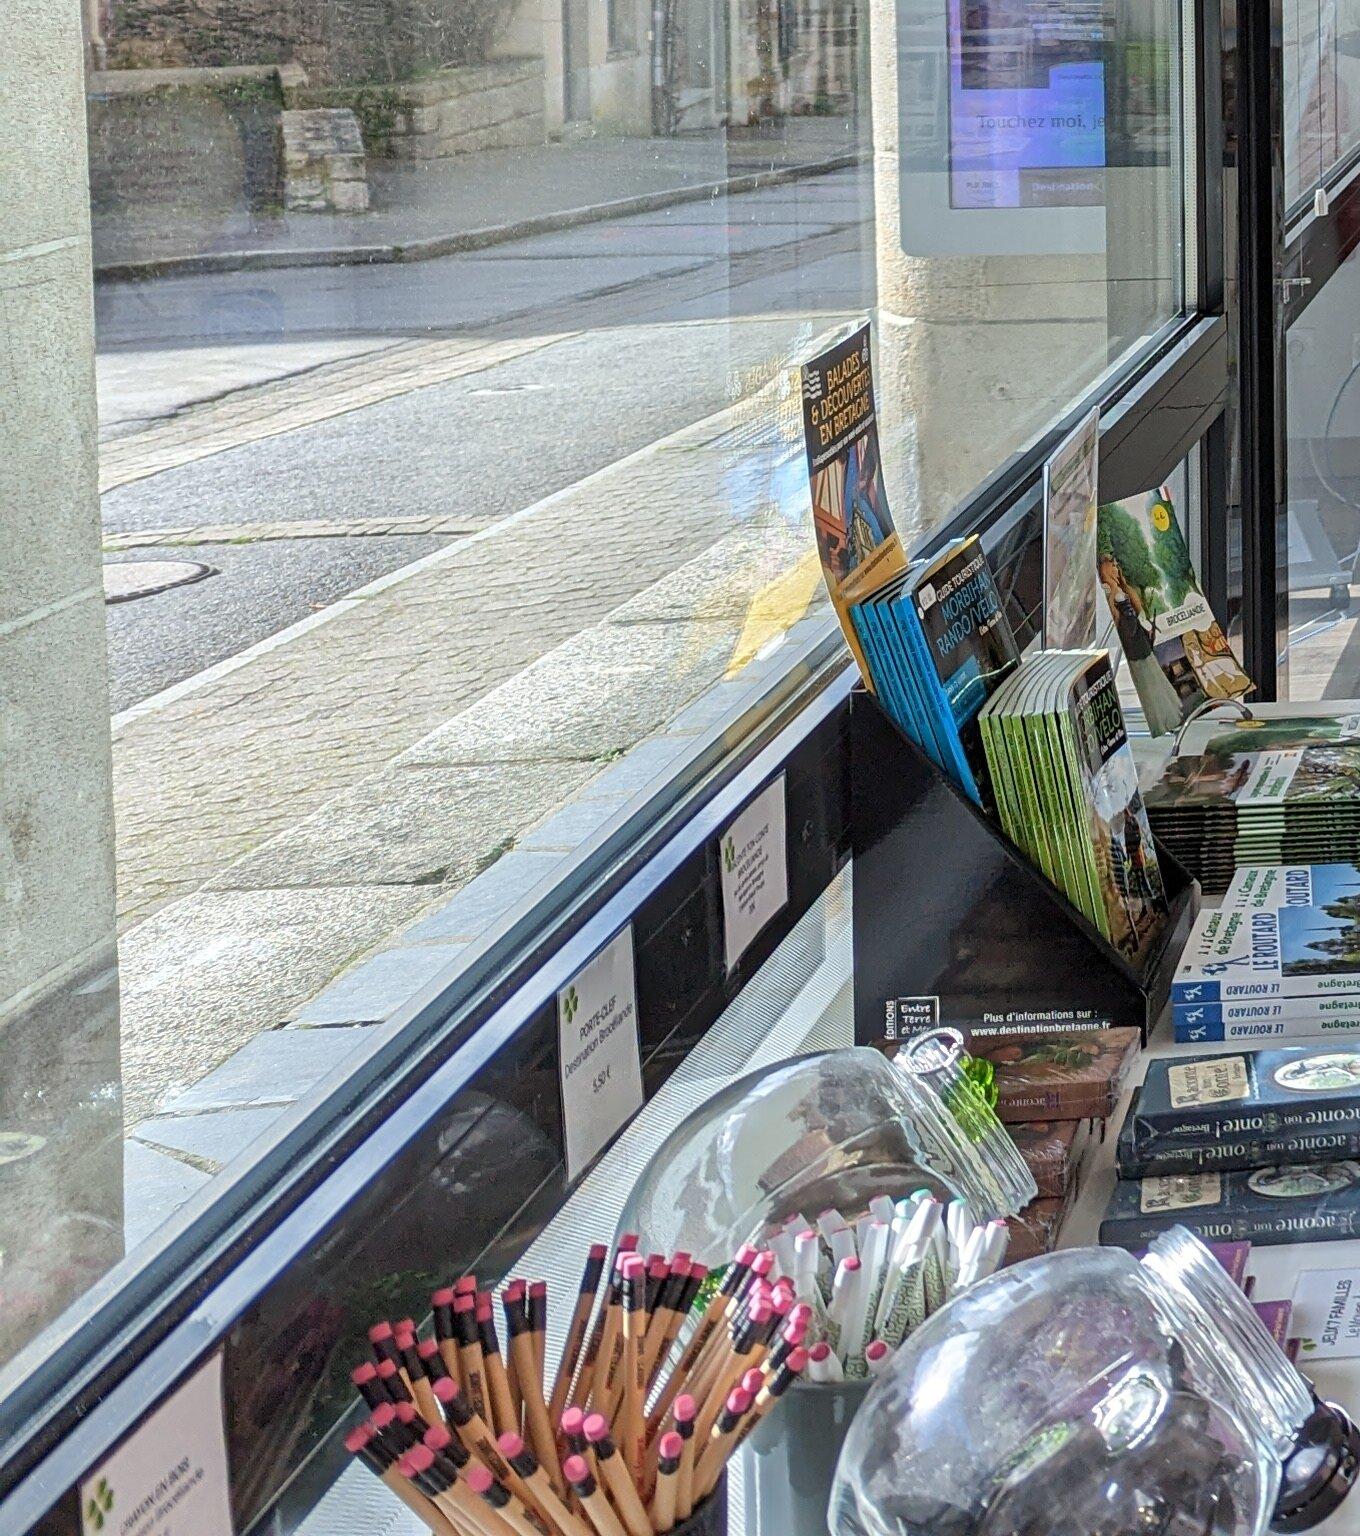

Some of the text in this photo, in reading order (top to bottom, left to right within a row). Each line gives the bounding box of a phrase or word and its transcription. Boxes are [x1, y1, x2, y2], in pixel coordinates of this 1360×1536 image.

[976, 114, 1045, 129] Touchez
[826, 350, 860, 391] BALADES
[811, 405, 819, 426] &
[819, 419, 834, 445] EN
[833, 391, 870, 437] BRETAGNE
[936, 553, 985, 602] GUIDE TOURISTIQUE
[941, 570, 991, 625] MORBIHAN
[1238, 869, 1259, 894] Canaux
[1250, 869, 1278, 908] de Bretagne
[1285, 869, 1310, 906] OUTARD
[1201, 912, 1223, 939] Canaux
[1214, 912, 1243, 956] de Bretagne
[1251, 912, 1279, 971] LE ROUTARD
[1226, 983, 1281, 995] LE ROUTARD
[900, 1004, 931, 1014] Entre
[902, 1014, 931, 1024] Terre
[983, 1013, 1004, 1023] Plus
[1006, 1010, 1074, 1023] d'informations
[1076, 1010, 1092, 1019] sur
[1227, 1005, 1282, 1018] LE ROUTARD
[884, 1000, 895, 1040] ÉDITIONS
[901, 1025, 910, 1035] et
[970, 1021, 1111, 1037] www.destinationbretagne.fr
[1230, 1023, 1284, 1035] LE ROUTARD
[1284, 1113, 1303, 1125] ton
[1266, 1142, 1285, 1152] ton
[1253, 1222, 1273, 1233] ton
[1329, 1279, 1353, 1320] FAMILLES
[1321, 1324, 1339, 1345] JEUX
[1345, 1327, 1360, 1339] Le
